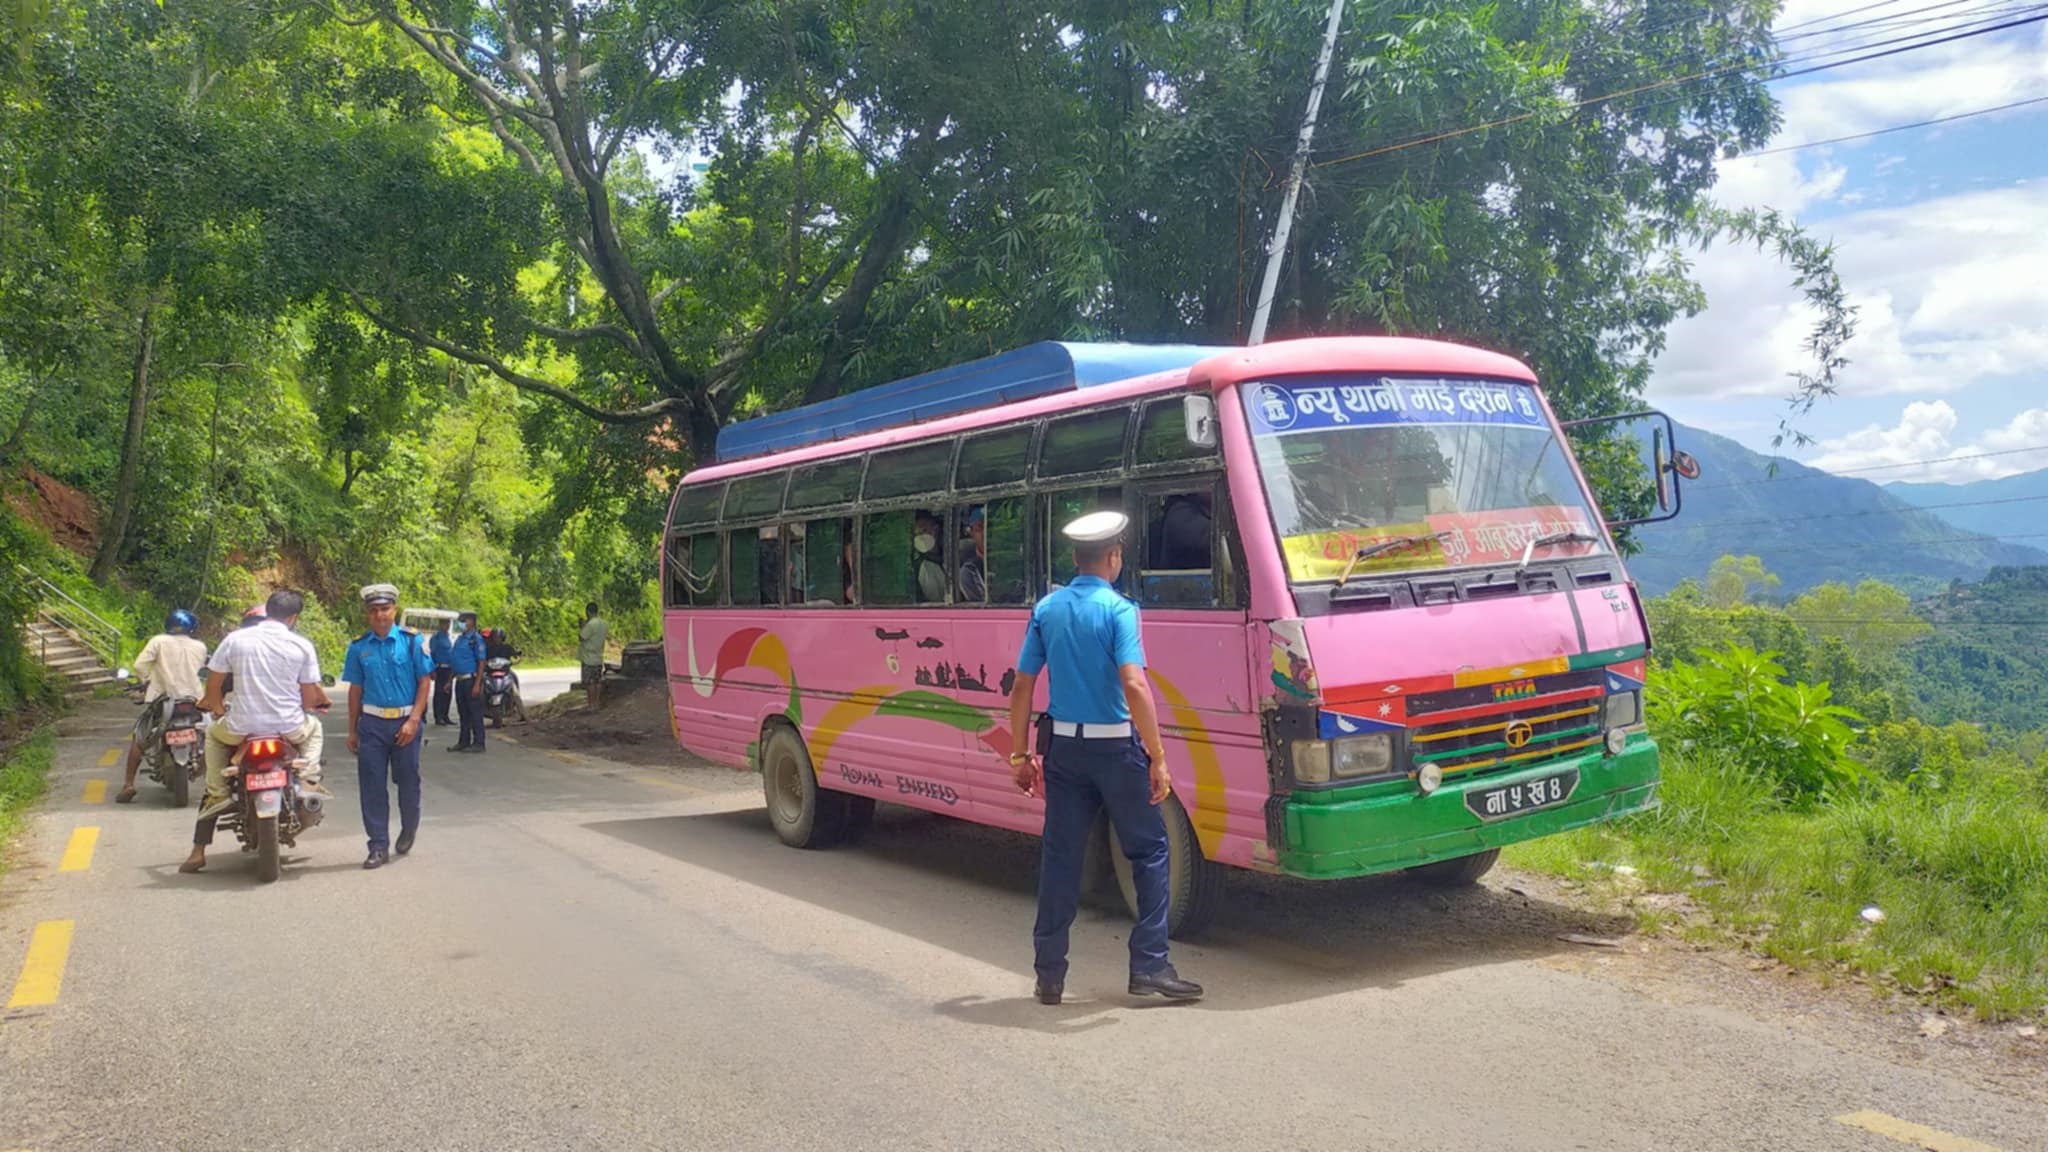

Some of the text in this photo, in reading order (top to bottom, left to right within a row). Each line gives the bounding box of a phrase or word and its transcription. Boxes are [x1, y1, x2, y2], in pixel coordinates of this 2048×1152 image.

[1291, 386, 1350, 423] न्यू
[1455, 380, 1514, 415] दर्शन
[1491, 679, 1537, 703] TATA
[895, 774, 961, 806] ENFIELD
[1485, 789, 1508, 814] ना
[1527, 780, 1546, 806] ख
